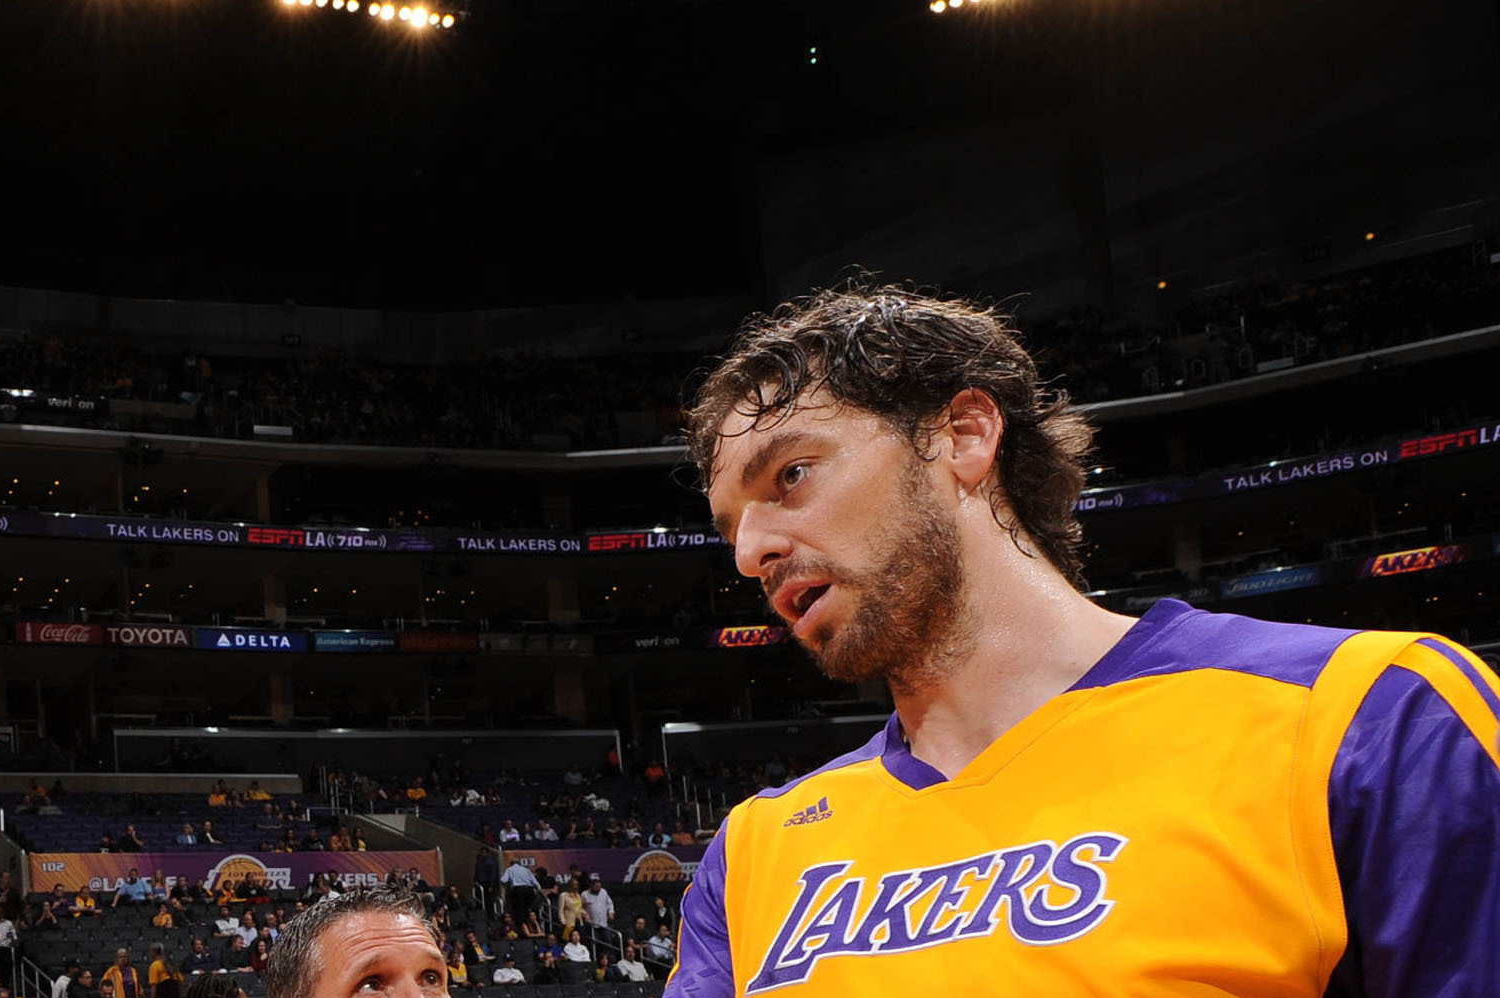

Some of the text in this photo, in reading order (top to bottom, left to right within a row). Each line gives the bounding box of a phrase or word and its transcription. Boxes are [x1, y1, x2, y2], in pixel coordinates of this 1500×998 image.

[1224, 471, 1273, 491] TALK
[1278, 455, 1355, 482] LAKERS
[1360, 450, 1389, 466] ON
[1400, 429, 1477, 459] ESPN
[106, 523, 148, 538] TALK
[152, 526, 213, 541] LAKERS
[217, 529, 239, 542] ON
[248, 527, 304, 545] ESPN
[305, 531, 326, 547] LA
[458, 537, 496, 550] TALK
[500, 539, 557, 551] LAKERS
[560, 539, 580, 552] ON
[588, 533, 646, 551] ESPN
[647, 533, 668, 548] LA
[106, 626, 189, 645] TOYOTA
[235, 633, 291, 648] DELTA
[316, 636, 359, 646] American
[360, 636, 395, 647] Express
[783, 810, 834, 828] adidas
[42, 861, 66, 872] 102
[743, 830, 1130, 998] LAKERS
